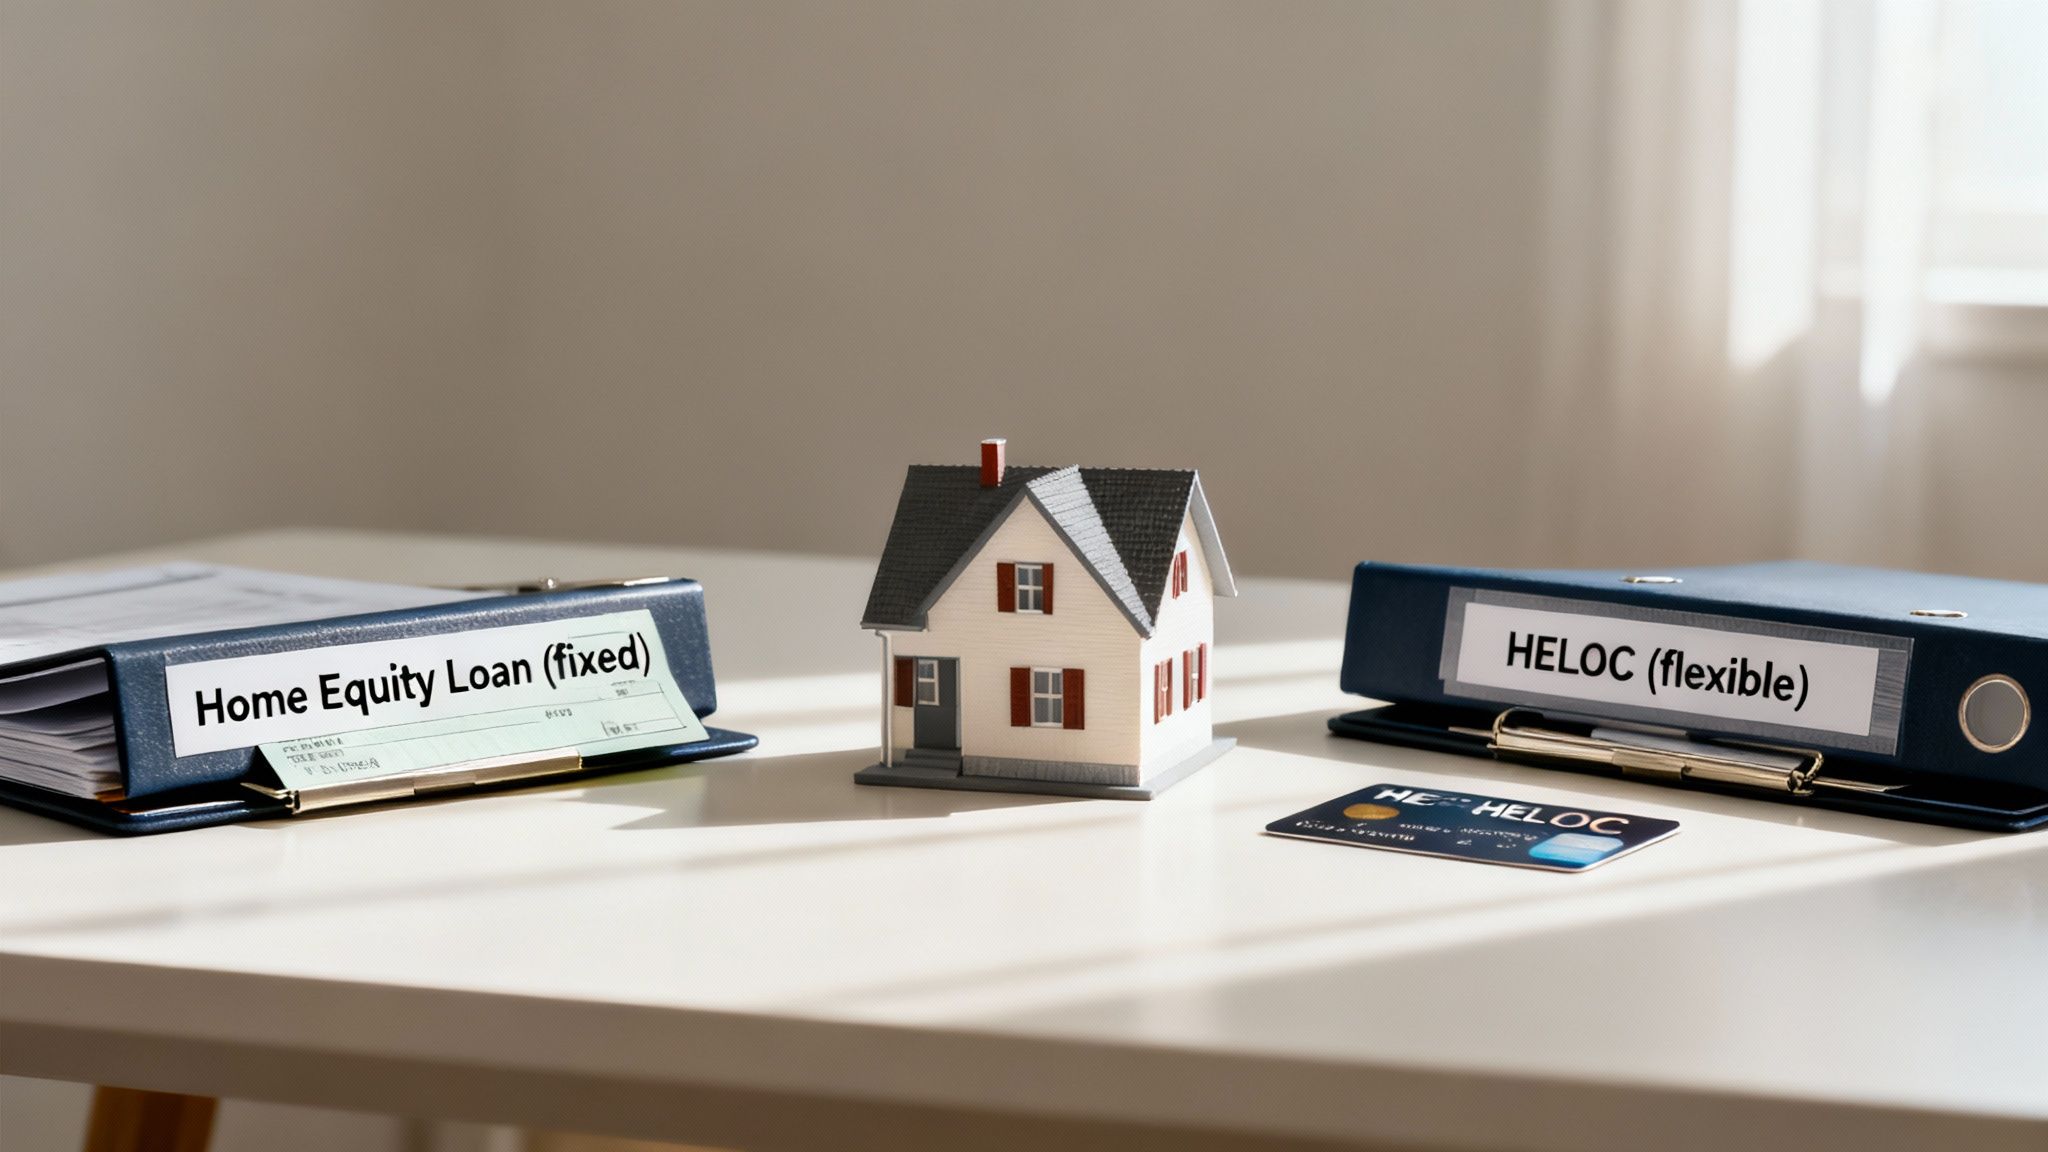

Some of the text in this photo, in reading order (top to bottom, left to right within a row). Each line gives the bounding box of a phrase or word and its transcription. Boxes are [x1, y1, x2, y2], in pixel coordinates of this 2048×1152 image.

[195, 631, 650, 727] Home Equity Loan (fixed)
[1506, 631, 1810, 712] HELOC (flexible)
[1471, 800, 1630, 835] HELOC
